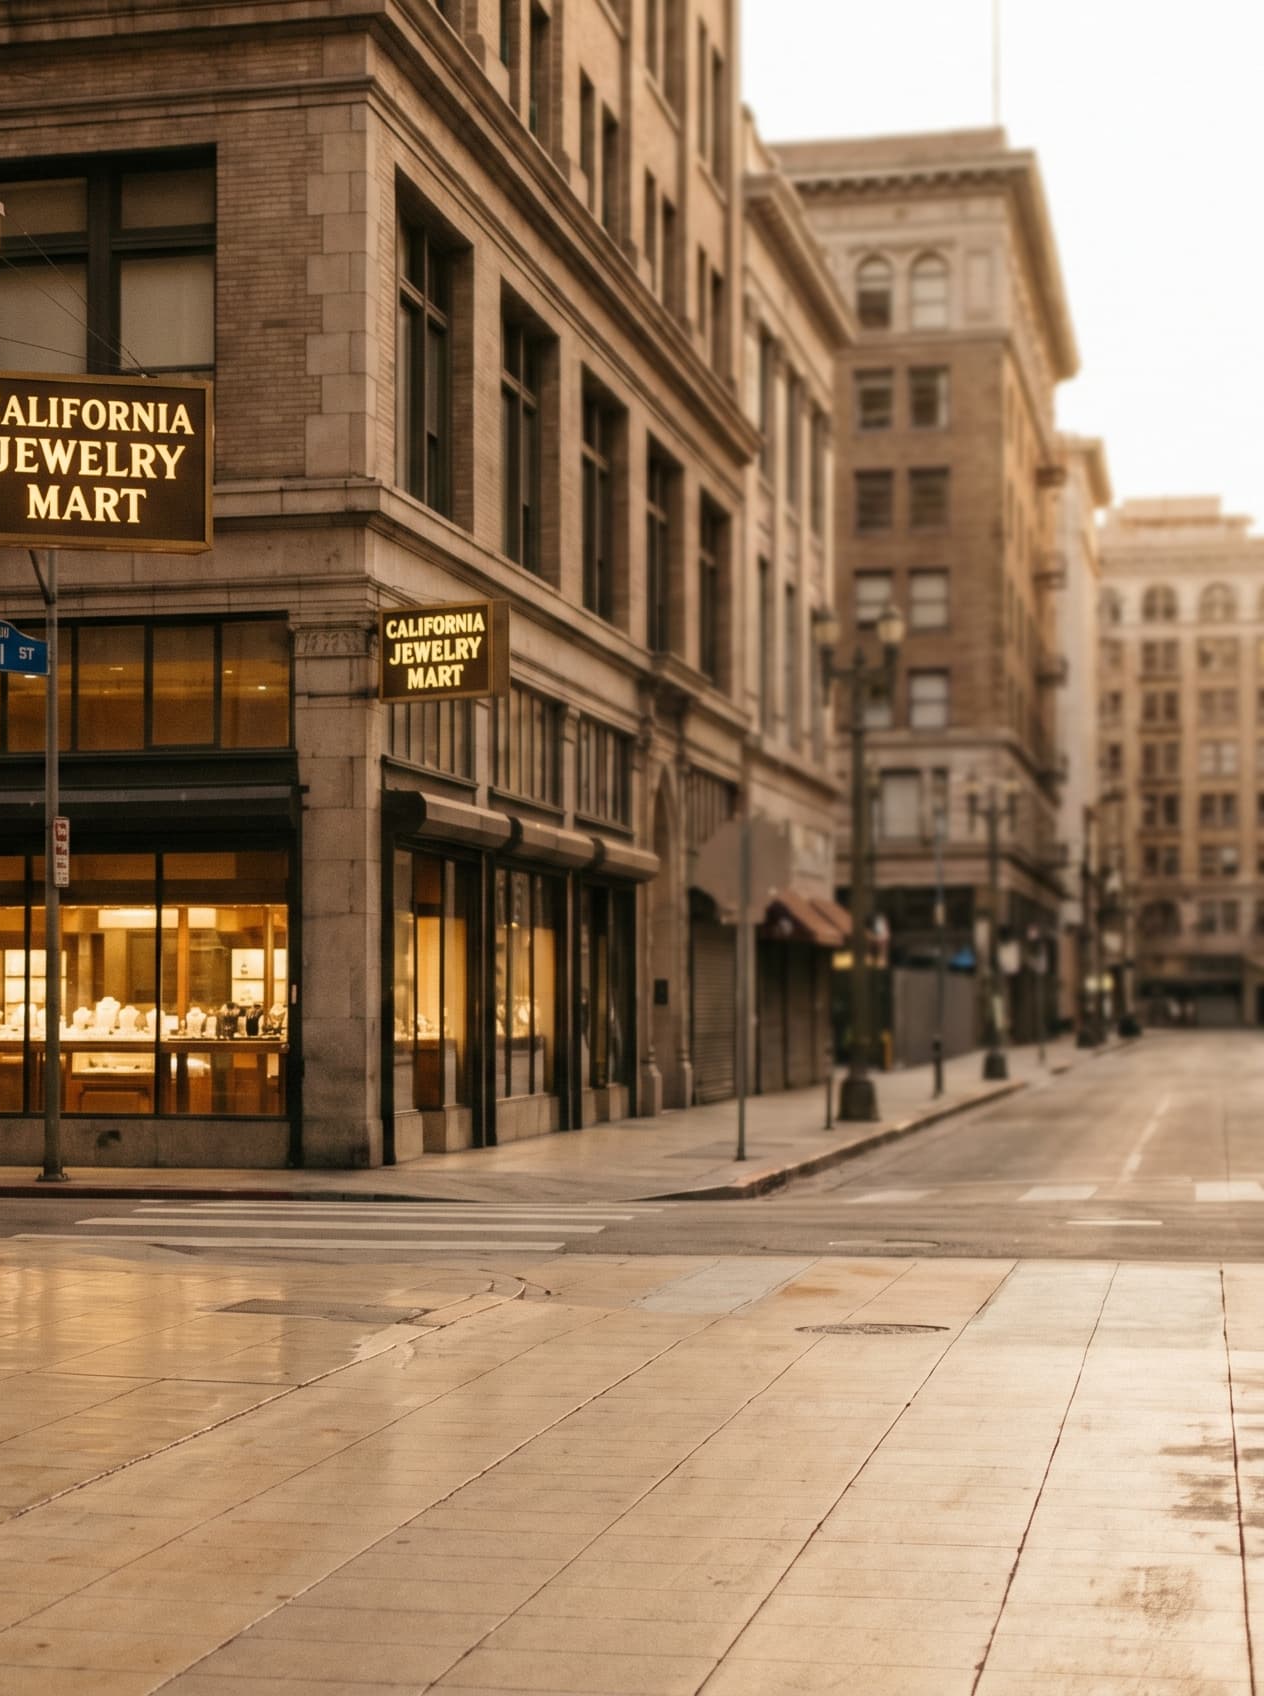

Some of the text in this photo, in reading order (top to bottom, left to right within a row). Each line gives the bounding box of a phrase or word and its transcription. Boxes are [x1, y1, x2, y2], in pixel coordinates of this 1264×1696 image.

[27, 483, 147, 523] MART
[385, 612, 486, 639] CALIFORNIA
[18, 646, 35, 660] ST
[389, 636, 482, 665] JEWELRY
[407, 664, 464, 690] MART
